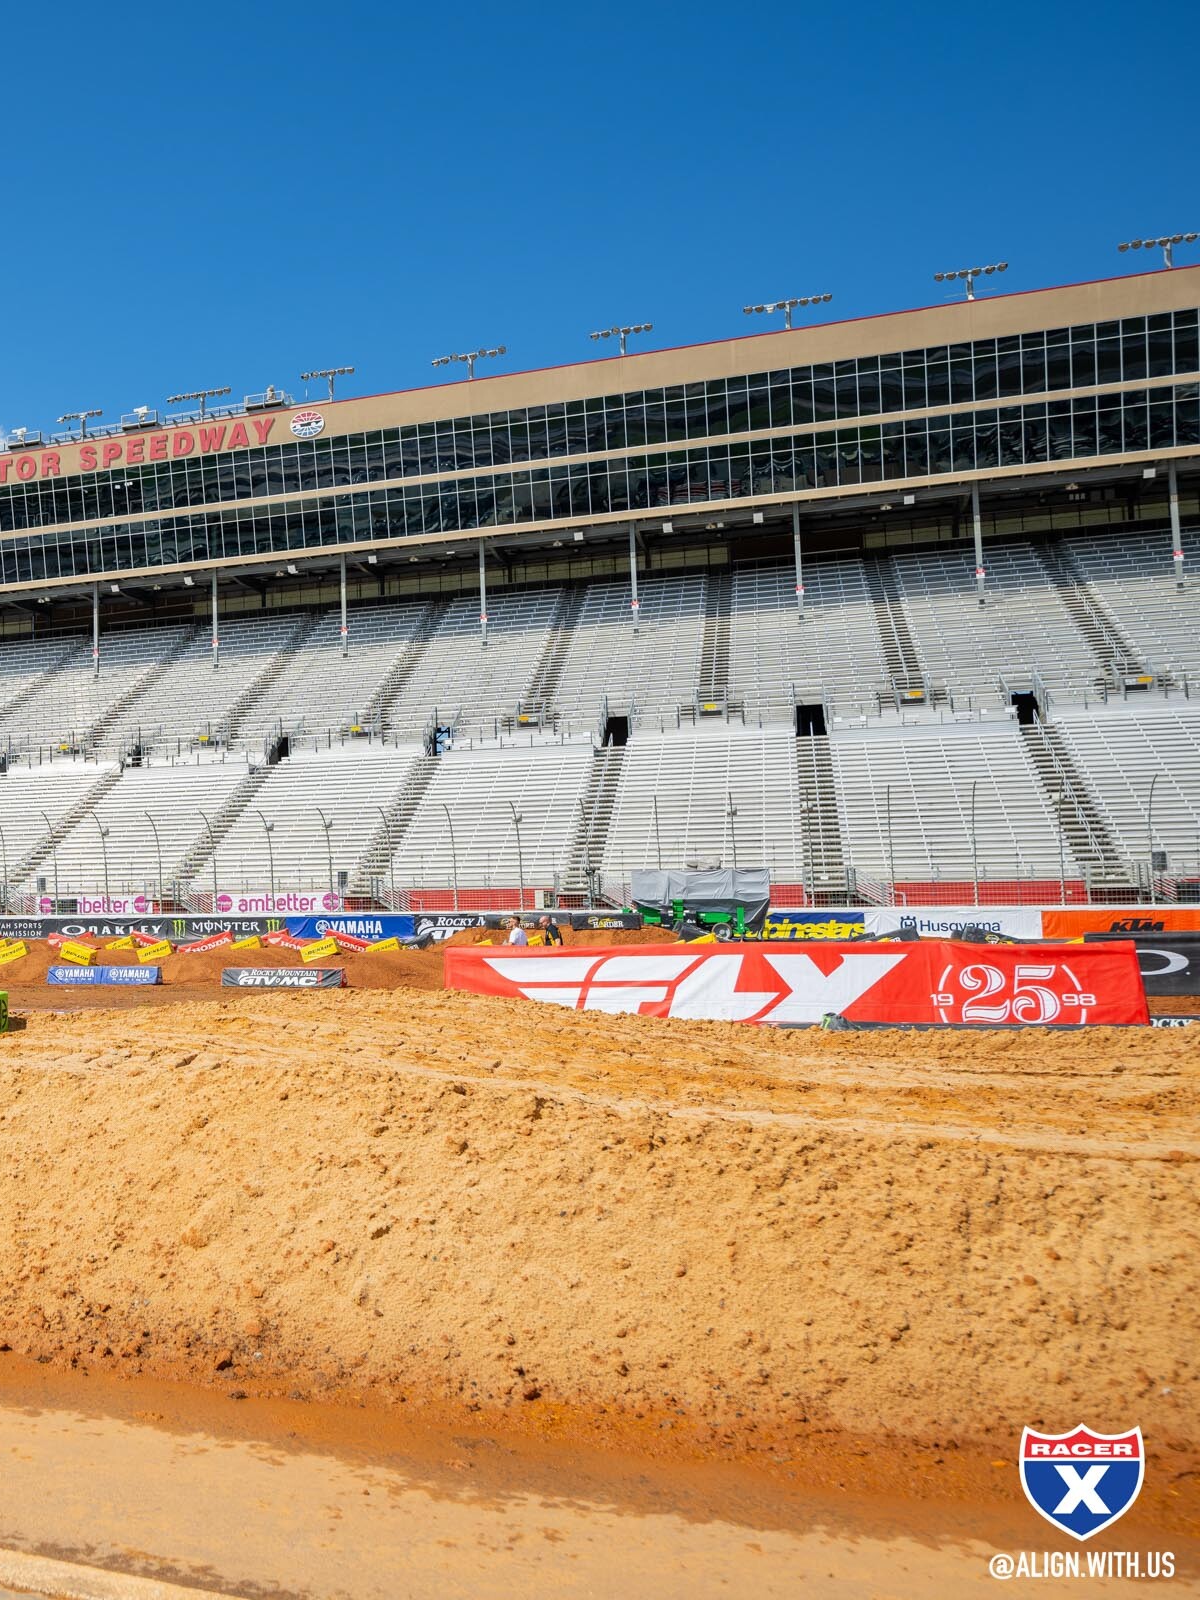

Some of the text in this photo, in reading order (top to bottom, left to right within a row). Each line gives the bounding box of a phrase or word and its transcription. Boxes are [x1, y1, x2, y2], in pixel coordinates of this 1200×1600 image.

[79, 418, 275, 471] SPEEDWAY
[77, 896, 129, 914] better
[238, 893, 317, 912] ambetter
[192, 919, 260, 933] MONSTER
[330, 920, 383, 934] YAMAHA
[436, 916, 475, 926] ROCKY
[763, 918, 865, 938] pinestars
[920, 920, 1001, 932] Husqvarna
[1109, 918, 1166, 932] KTM
[192, 937, 231, 953] HONDA
[64, 969, 94, 977] YAMAHA
[119, 969, 149, 978] YAMAHA
[276, 969, 318, 977] MOUNTAIN
[930, 964, 1097, 1024] 19 25 98
